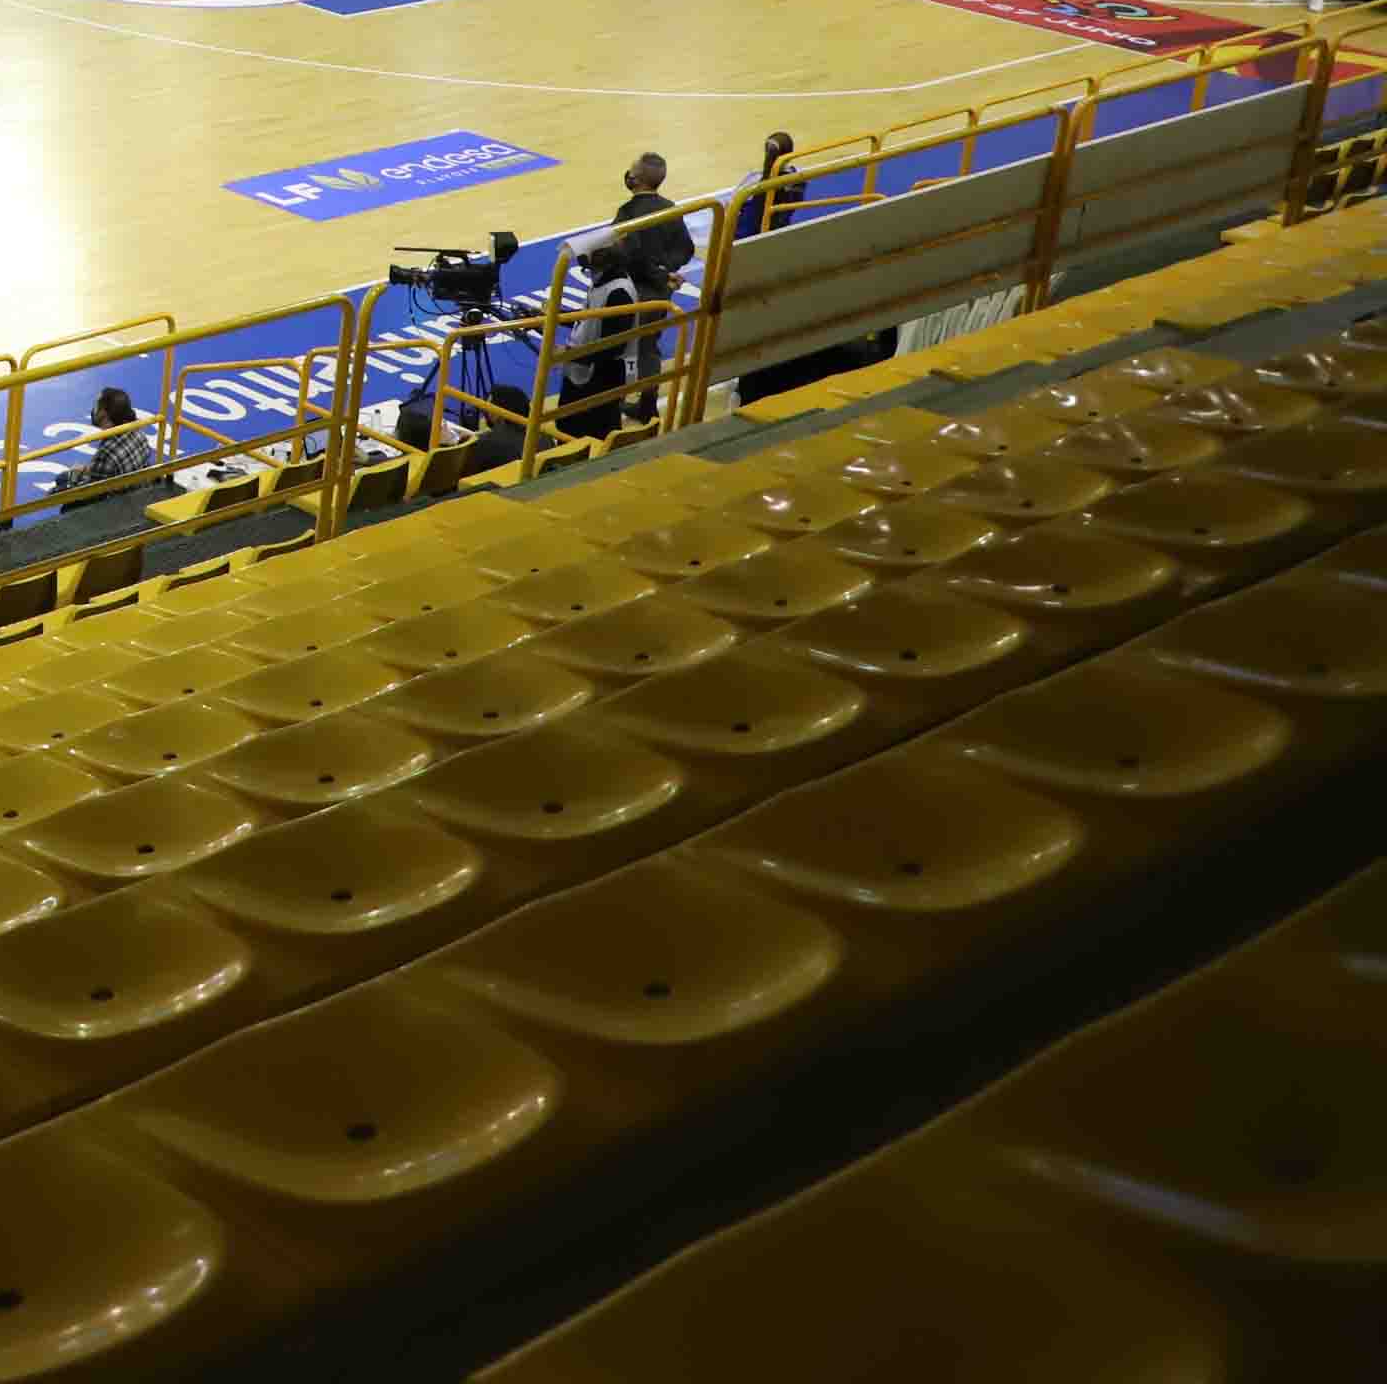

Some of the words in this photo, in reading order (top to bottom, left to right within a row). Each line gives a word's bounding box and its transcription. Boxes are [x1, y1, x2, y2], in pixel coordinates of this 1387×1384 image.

[1043, 15, 1158, 48] JUNIO
[255, 180, 324, 208] LF
[380, 142, 518, 180] endesa
